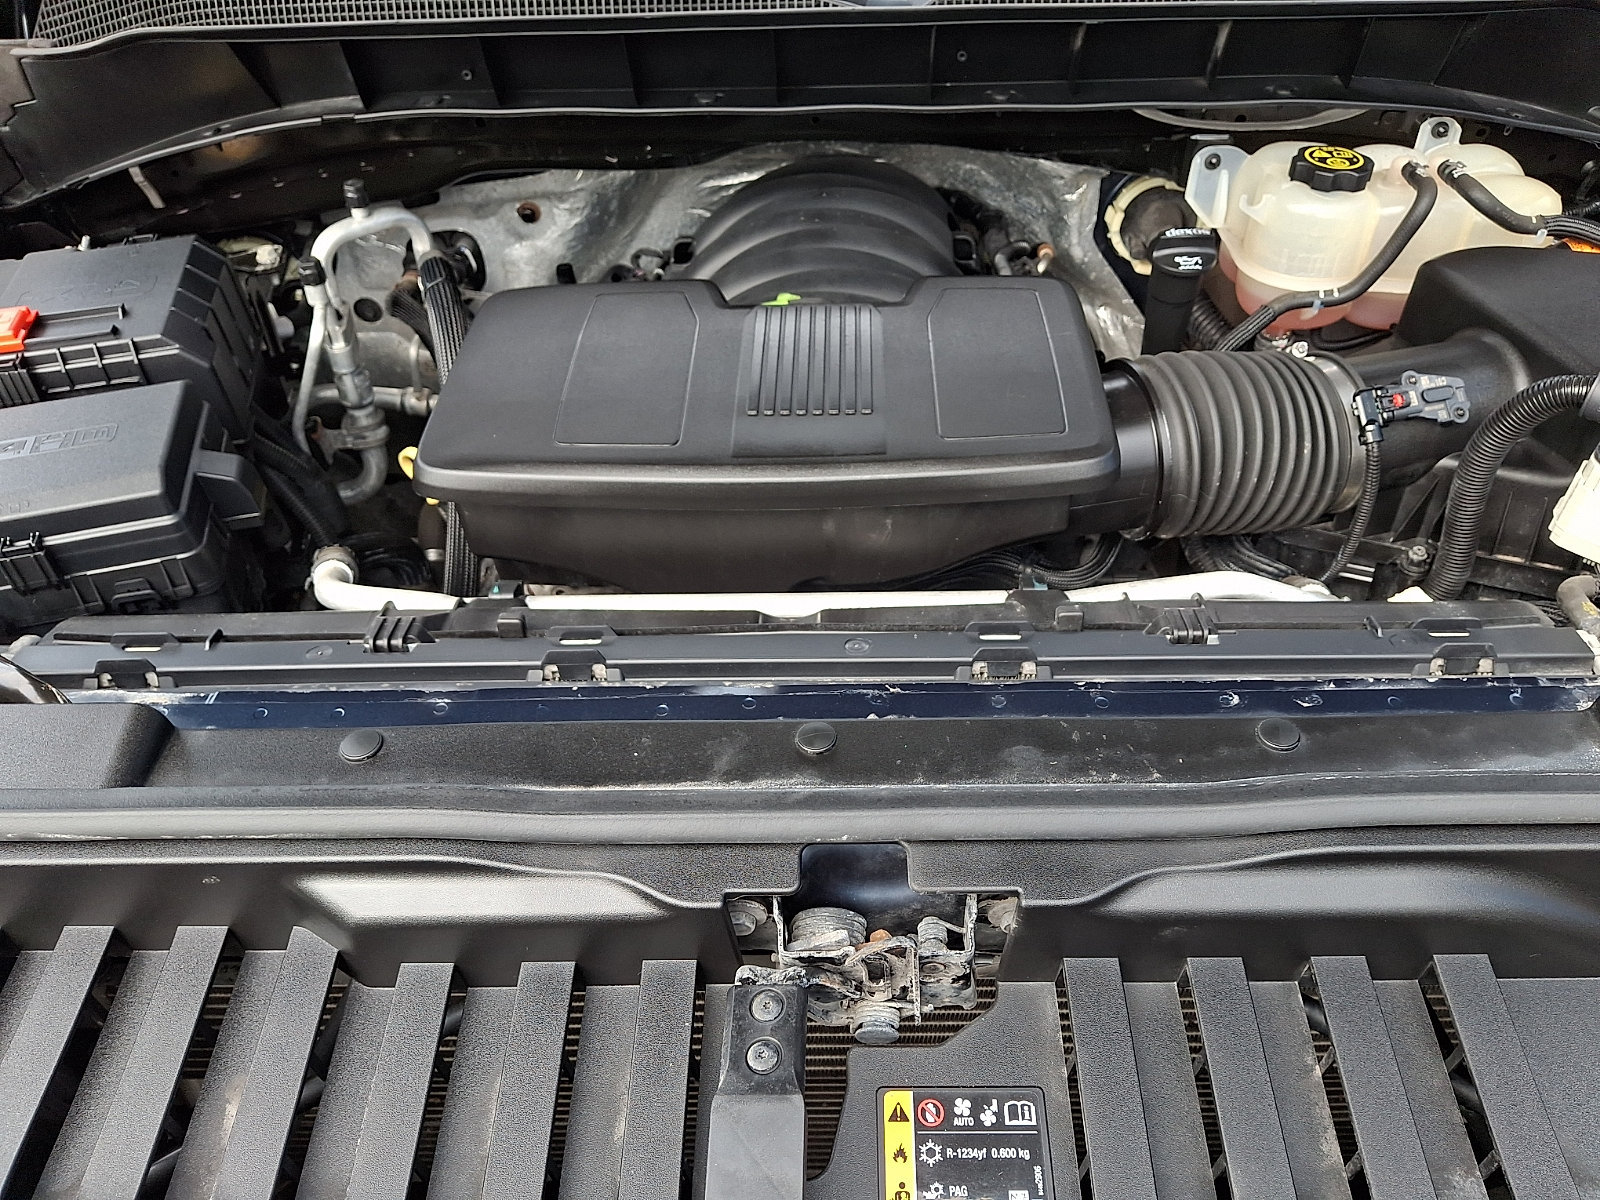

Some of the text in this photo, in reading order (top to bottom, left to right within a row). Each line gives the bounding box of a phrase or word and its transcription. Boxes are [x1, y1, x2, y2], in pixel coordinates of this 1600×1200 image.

[953, 1117, 974, 1126] AUTO
[946, 1148, 1031, 1160] R-1234yf 0.600 kg
[949, 1186, 968, 1197] PAG
